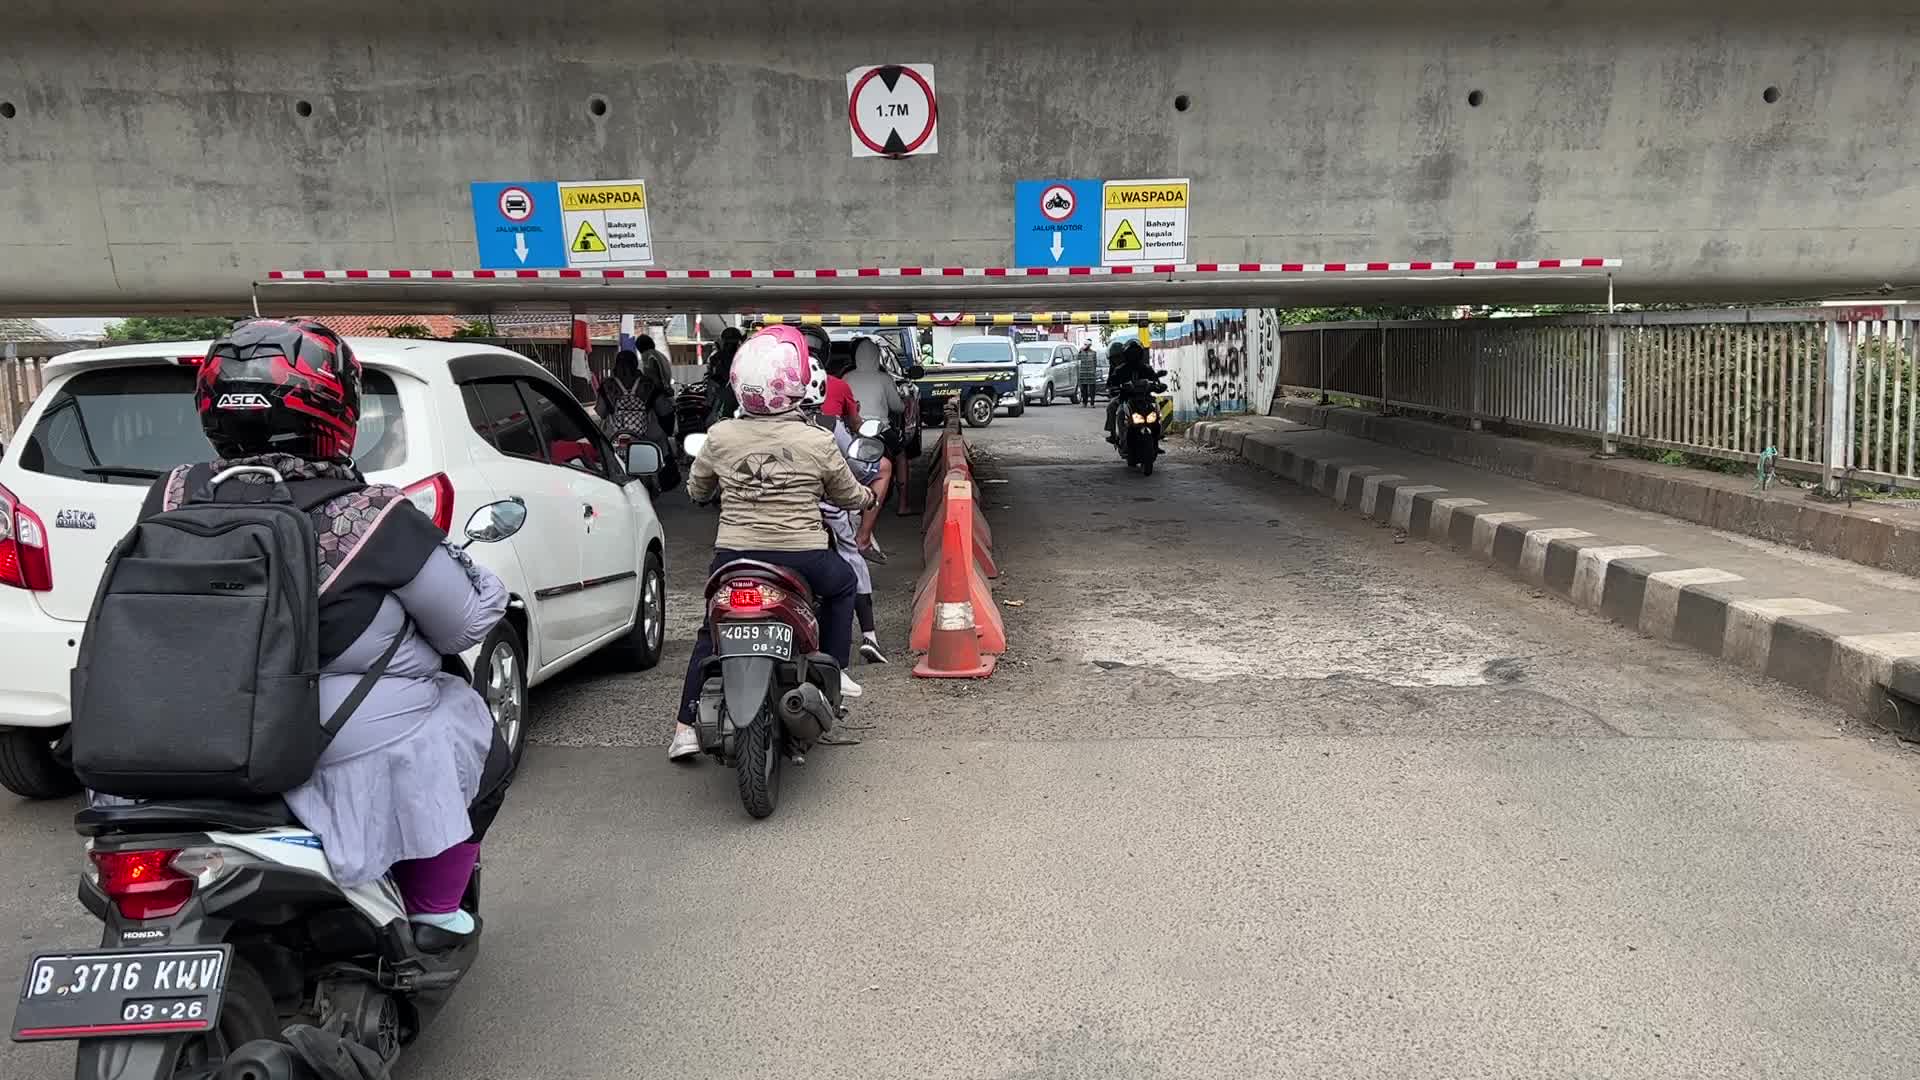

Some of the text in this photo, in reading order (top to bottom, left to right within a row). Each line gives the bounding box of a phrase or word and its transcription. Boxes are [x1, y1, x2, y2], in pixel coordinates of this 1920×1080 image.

[876, 104, 909, 117] 1.7M
[577, 191, 641, 204] WASPADA
[1121, 190, 1184, 203] WASPADA
[1032, 224, 1083, 232] JALUR MOTOR
[1146, 230, 1173, 238] kepala
[610, 241, 648, 249] terbentur.
[1146, 240, 1184, 248] terbentur.
[218, 393, 270, 406] ASCA
[57, 509, 96, 520] ASTRA
[726, 626, 759, 639] 4059
[123, 930, 164, 939] HONDA
[34, 958, 216, 995] B 3716 KWV
